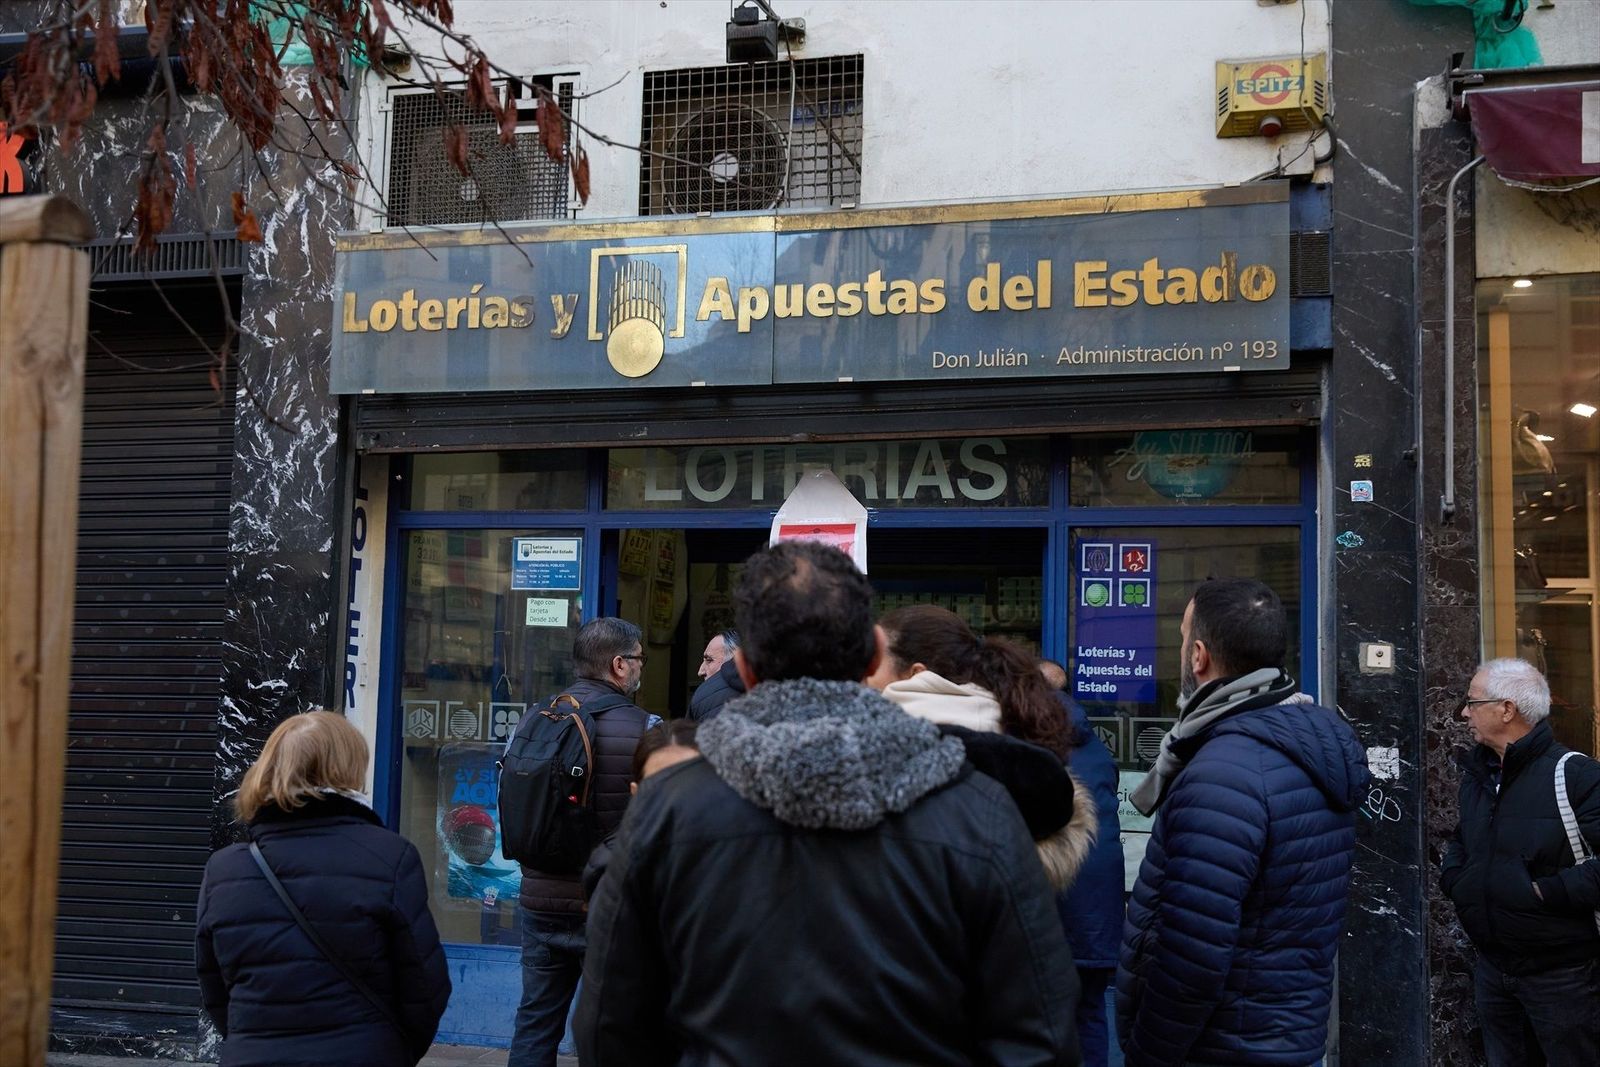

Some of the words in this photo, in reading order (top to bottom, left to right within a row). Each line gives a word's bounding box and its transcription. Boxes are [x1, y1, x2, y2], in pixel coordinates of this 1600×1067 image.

[1241, 75, 1303, 95] SPITZ
[695, 269, 946, 334] Apuestas
[967, 259, 1052, 313] del
[1074, 251, 1277, 309] Estado
[342, 283, 535, 334] Loterías
[550, 291, 580, 340] y
[932, 350, 969, 369] Don
[975, 347, 1029, 369] Julián
[1056, 343, 1204, 366] Administración
[1210, 341, 1234, 361] nº
[1240, 340, 1278, 360] 193
[1078, 645, 1125, 659] Loterías
[1129, 647, 1136, 661] y
[1077, 663, 1132, 678] Apuestas
[1134, 663, 1153, 677] del
[1077, 680, 1117, 694] Estado
